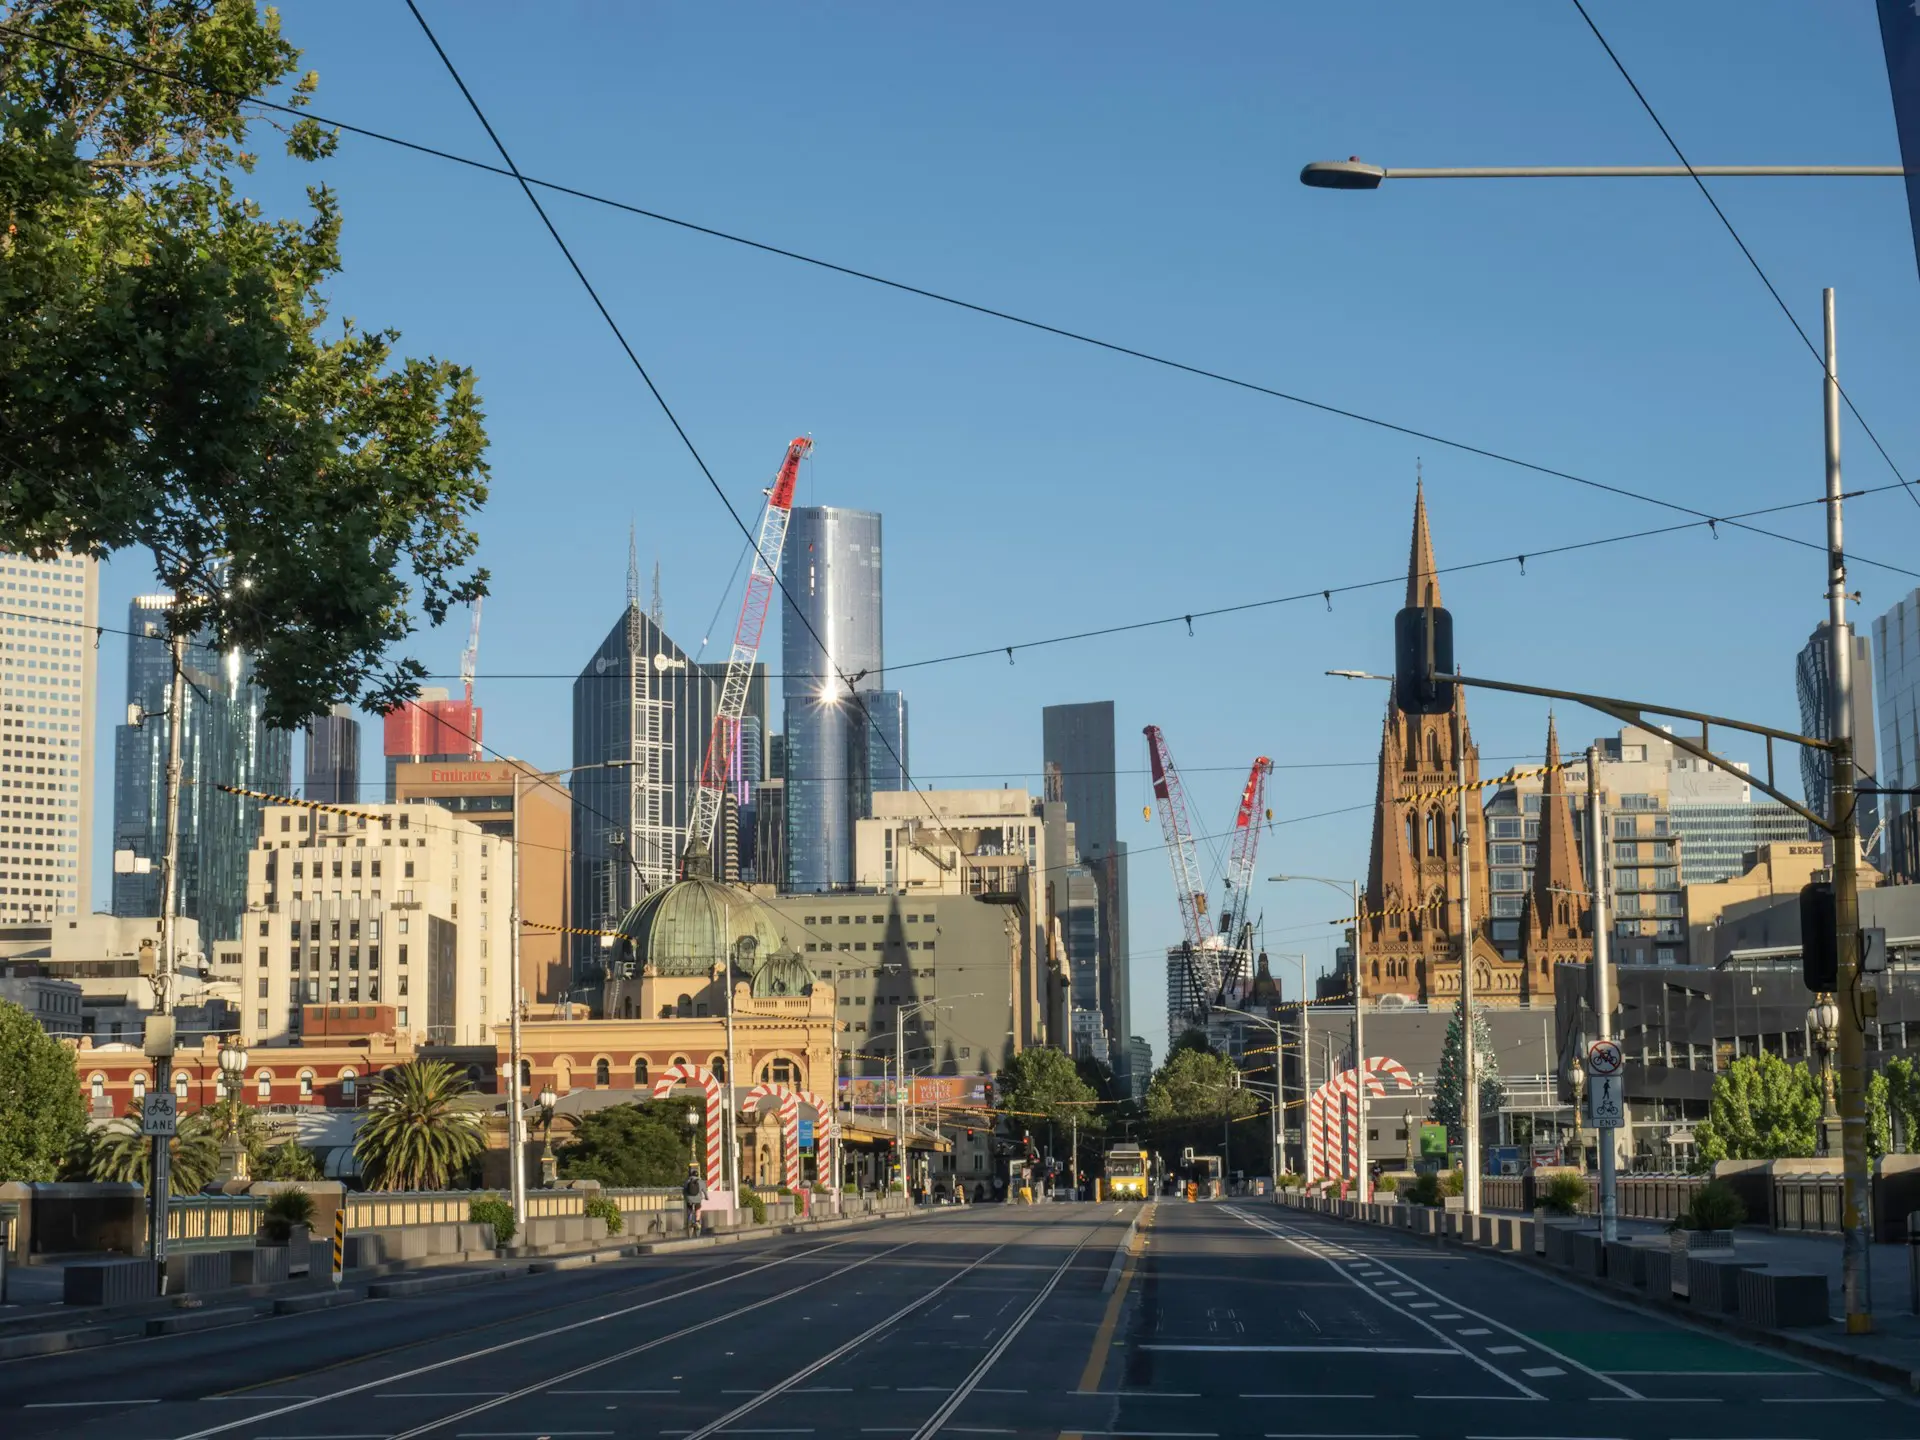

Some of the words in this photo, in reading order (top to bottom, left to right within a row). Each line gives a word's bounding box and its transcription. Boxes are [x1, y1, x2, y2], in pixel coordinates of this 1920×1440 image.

[431, 768, 492, 782] Emirates
[1789, 846, 1824, 855] REGE
[919, 1084, 952, 1092] WHTE
[146, 1120, 173, 1130] LANE
